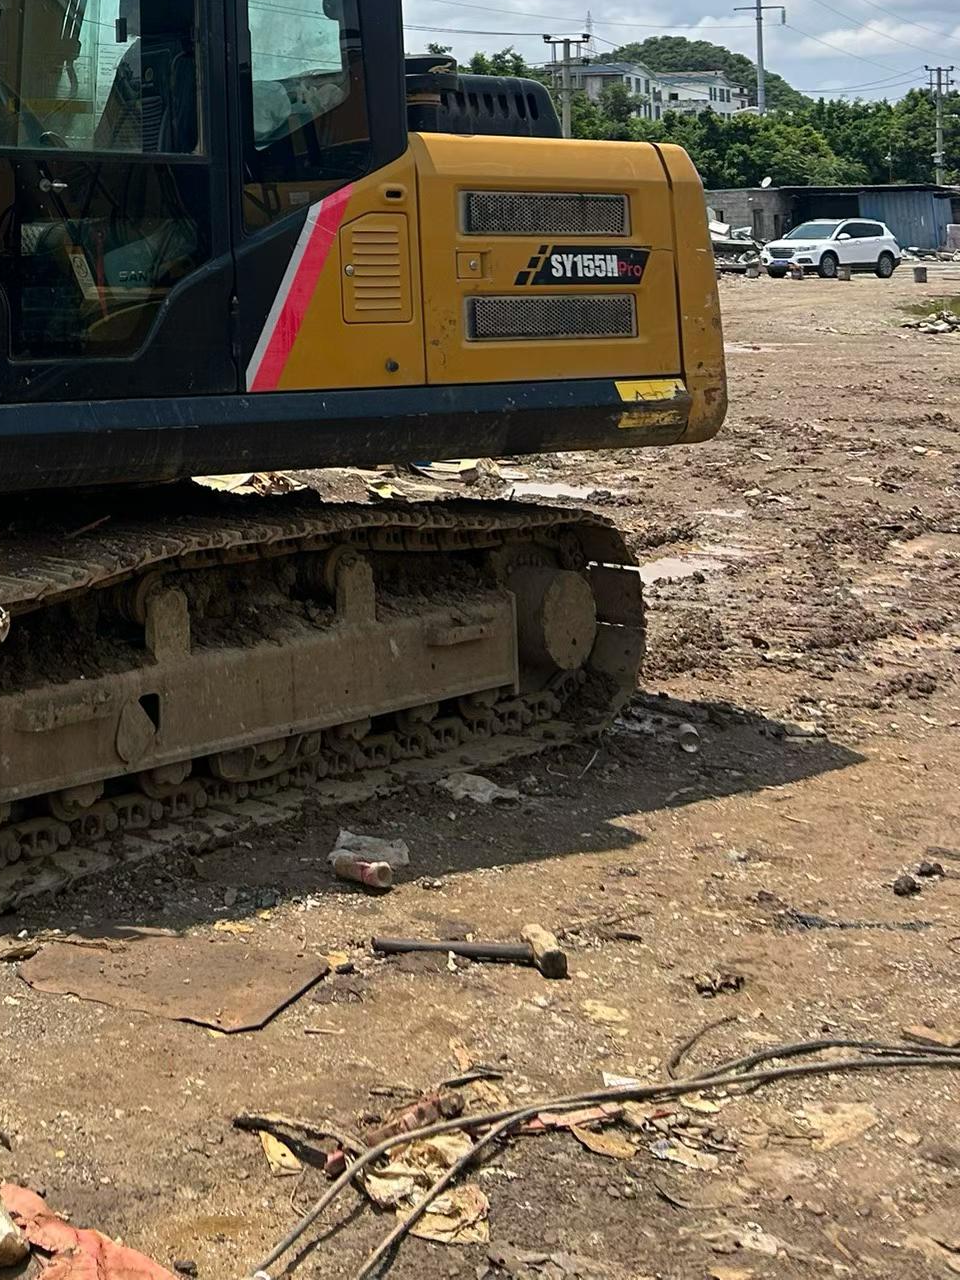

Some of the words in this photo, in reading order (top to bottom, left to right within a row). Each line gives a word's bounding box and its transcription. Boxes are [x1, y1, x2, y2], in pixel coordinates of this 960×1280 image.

[550, 253, 619, 277] SY155H
[618, 261, 642, 276] Pro
[119, 270, 147, 282] SAN
